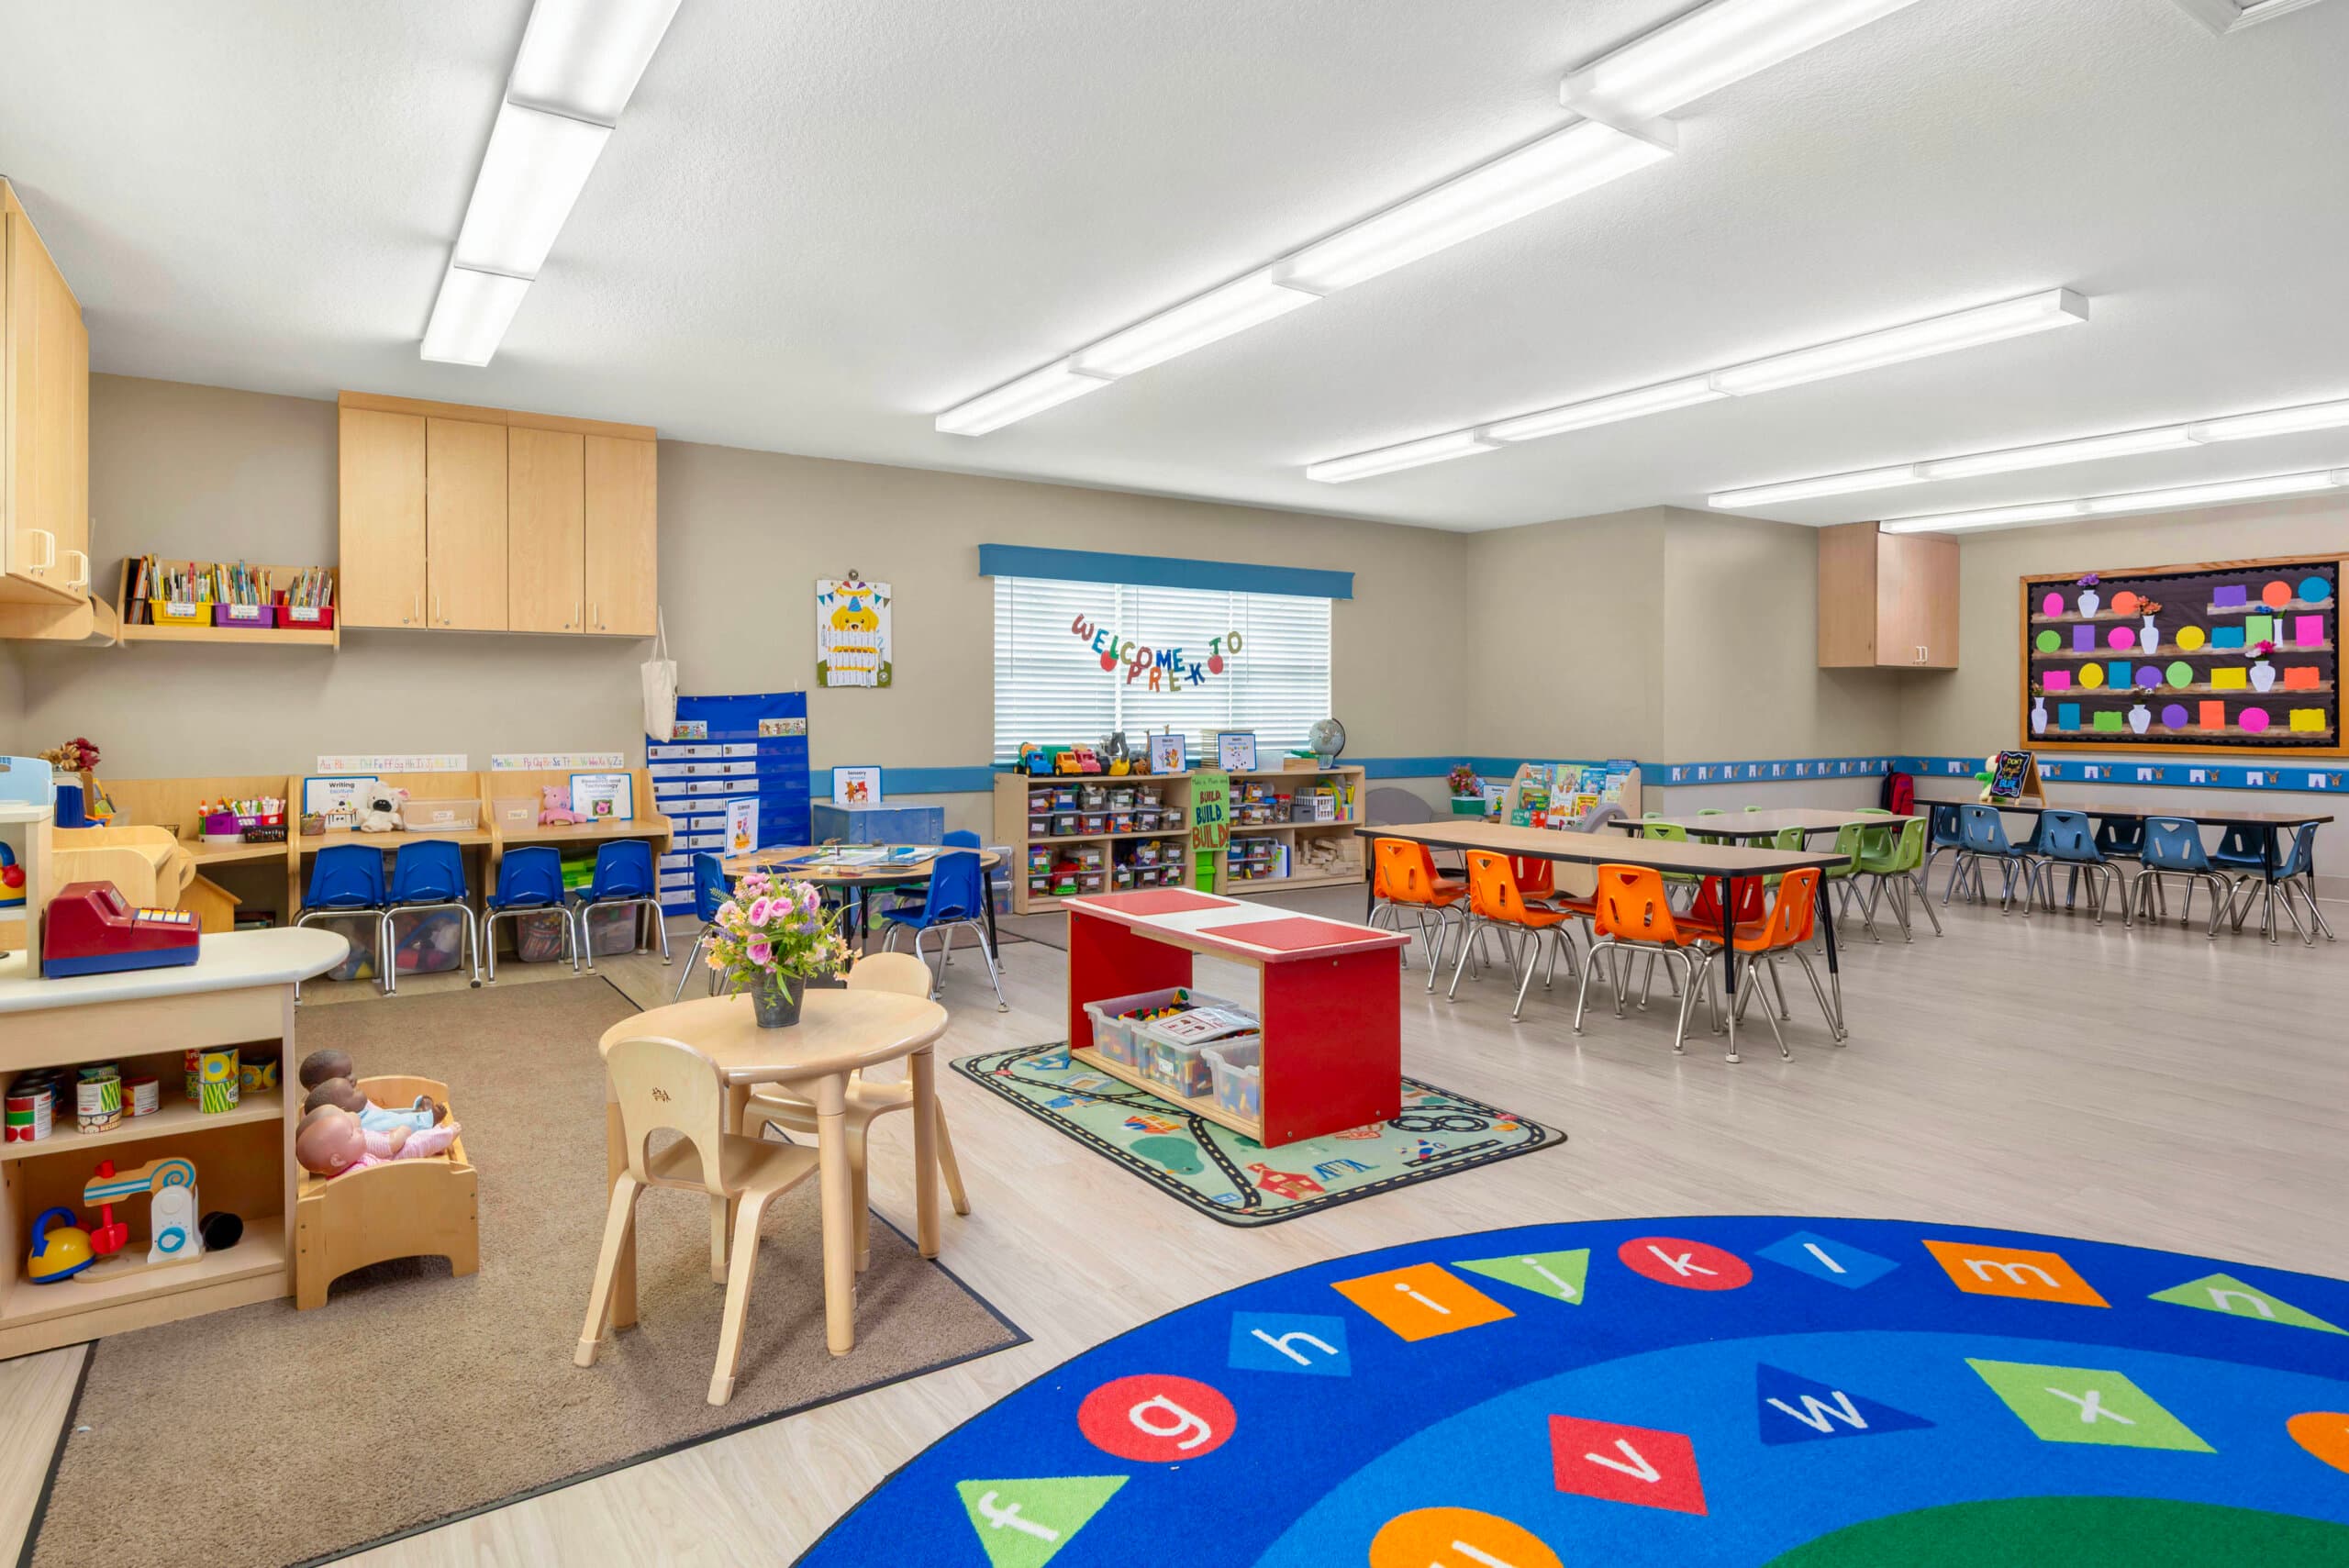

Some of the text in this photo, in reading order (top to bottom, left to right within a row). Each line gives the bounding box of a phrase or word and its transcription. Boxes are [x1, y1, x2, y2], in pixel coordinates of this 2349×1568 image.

[1072, 613, 1242, 673] WELCOME TO
[1192, 823, 1230, 850] BUILD!
[1196, 805, 1224, 825] BUILD.
[976, 1489, 1061, 1544] f
[1128, 1394, 1211, 1451] g
[1251, 1329, 1339, 1366] h
[1394, 1283, 1451, 1315] i
[1521, 1257, 1577, 1298] j
[1647, 1244, 1719, 1276] k
[1964, 1258, 2060, 1288] m
[2207, 1287, 2277, 1319] n
